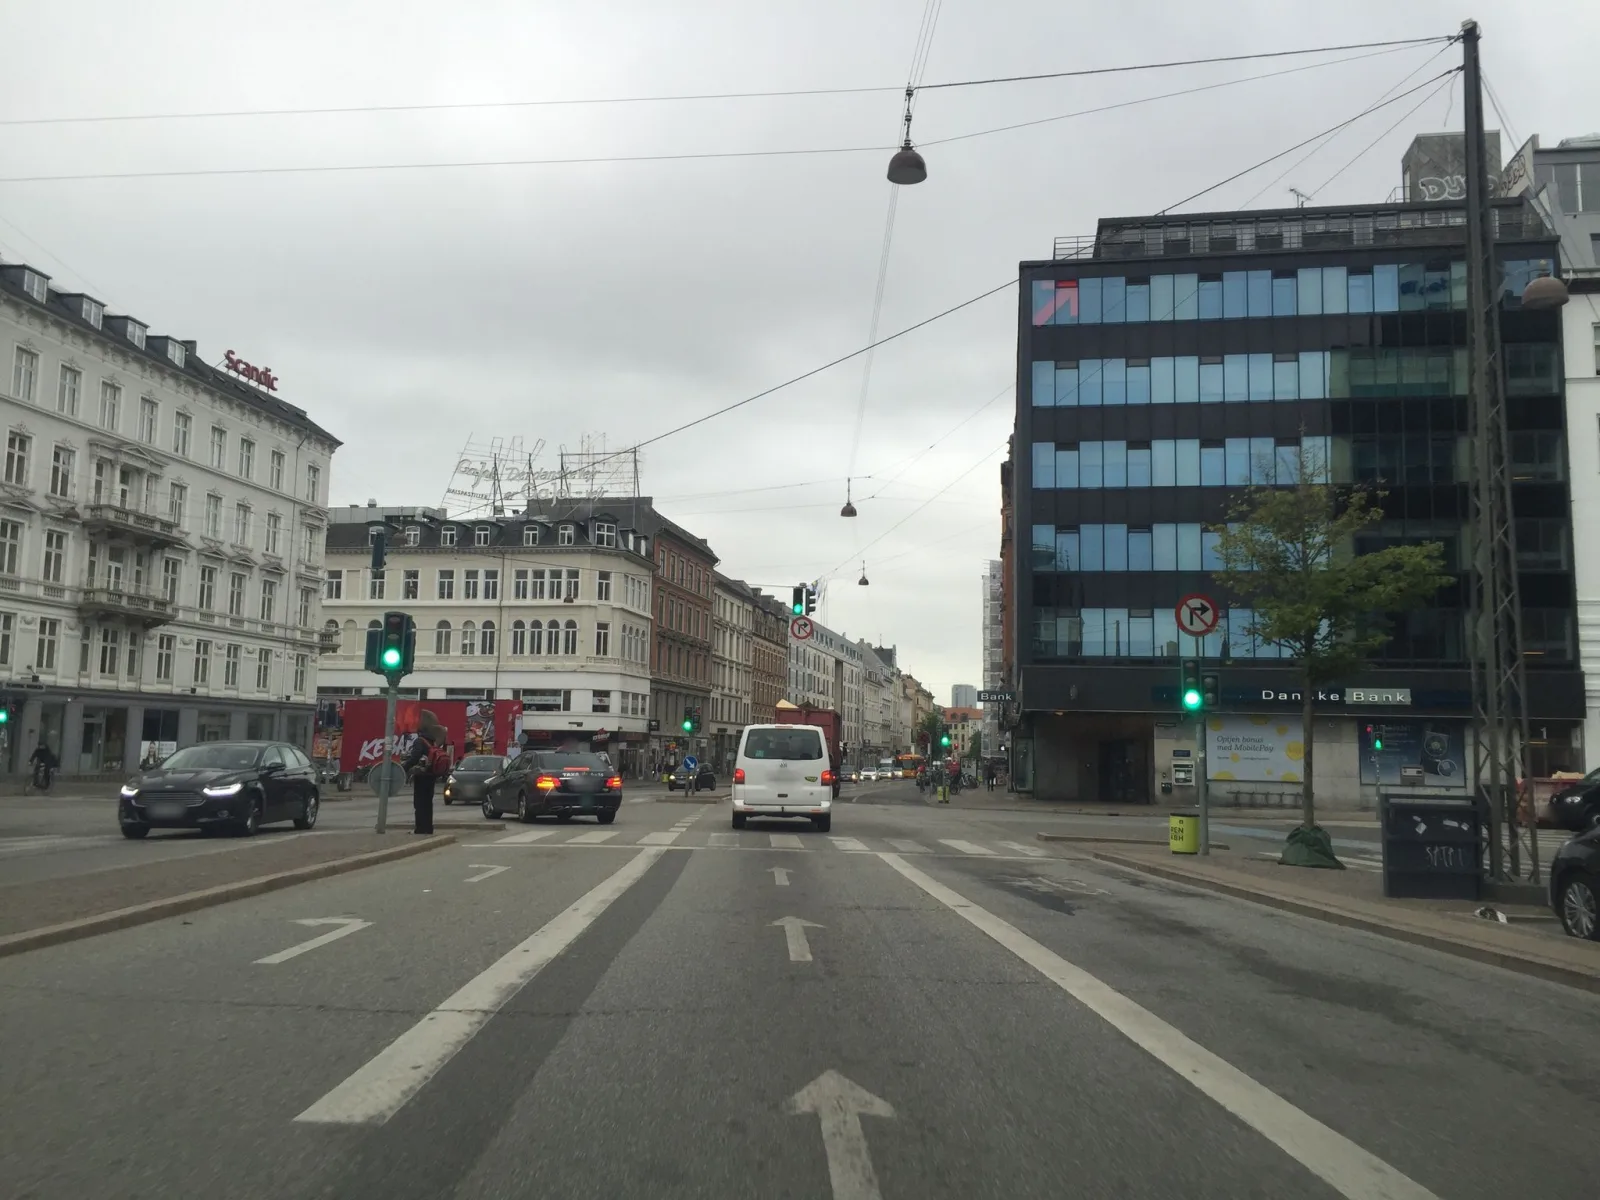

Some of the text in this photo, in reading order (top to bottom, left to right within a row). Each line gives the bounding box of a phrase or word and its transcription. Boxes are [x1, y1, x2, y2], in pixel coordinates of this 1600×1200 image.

[224, 349, 279, 391] Scandic
[980, 692, 1012, 701] Bank
[1261, 690, 1405, 702] Danke Bank
[1216, 735, 1264, 744] Optjen bonus
[1234, 744, 1274, 753] MobilePay
